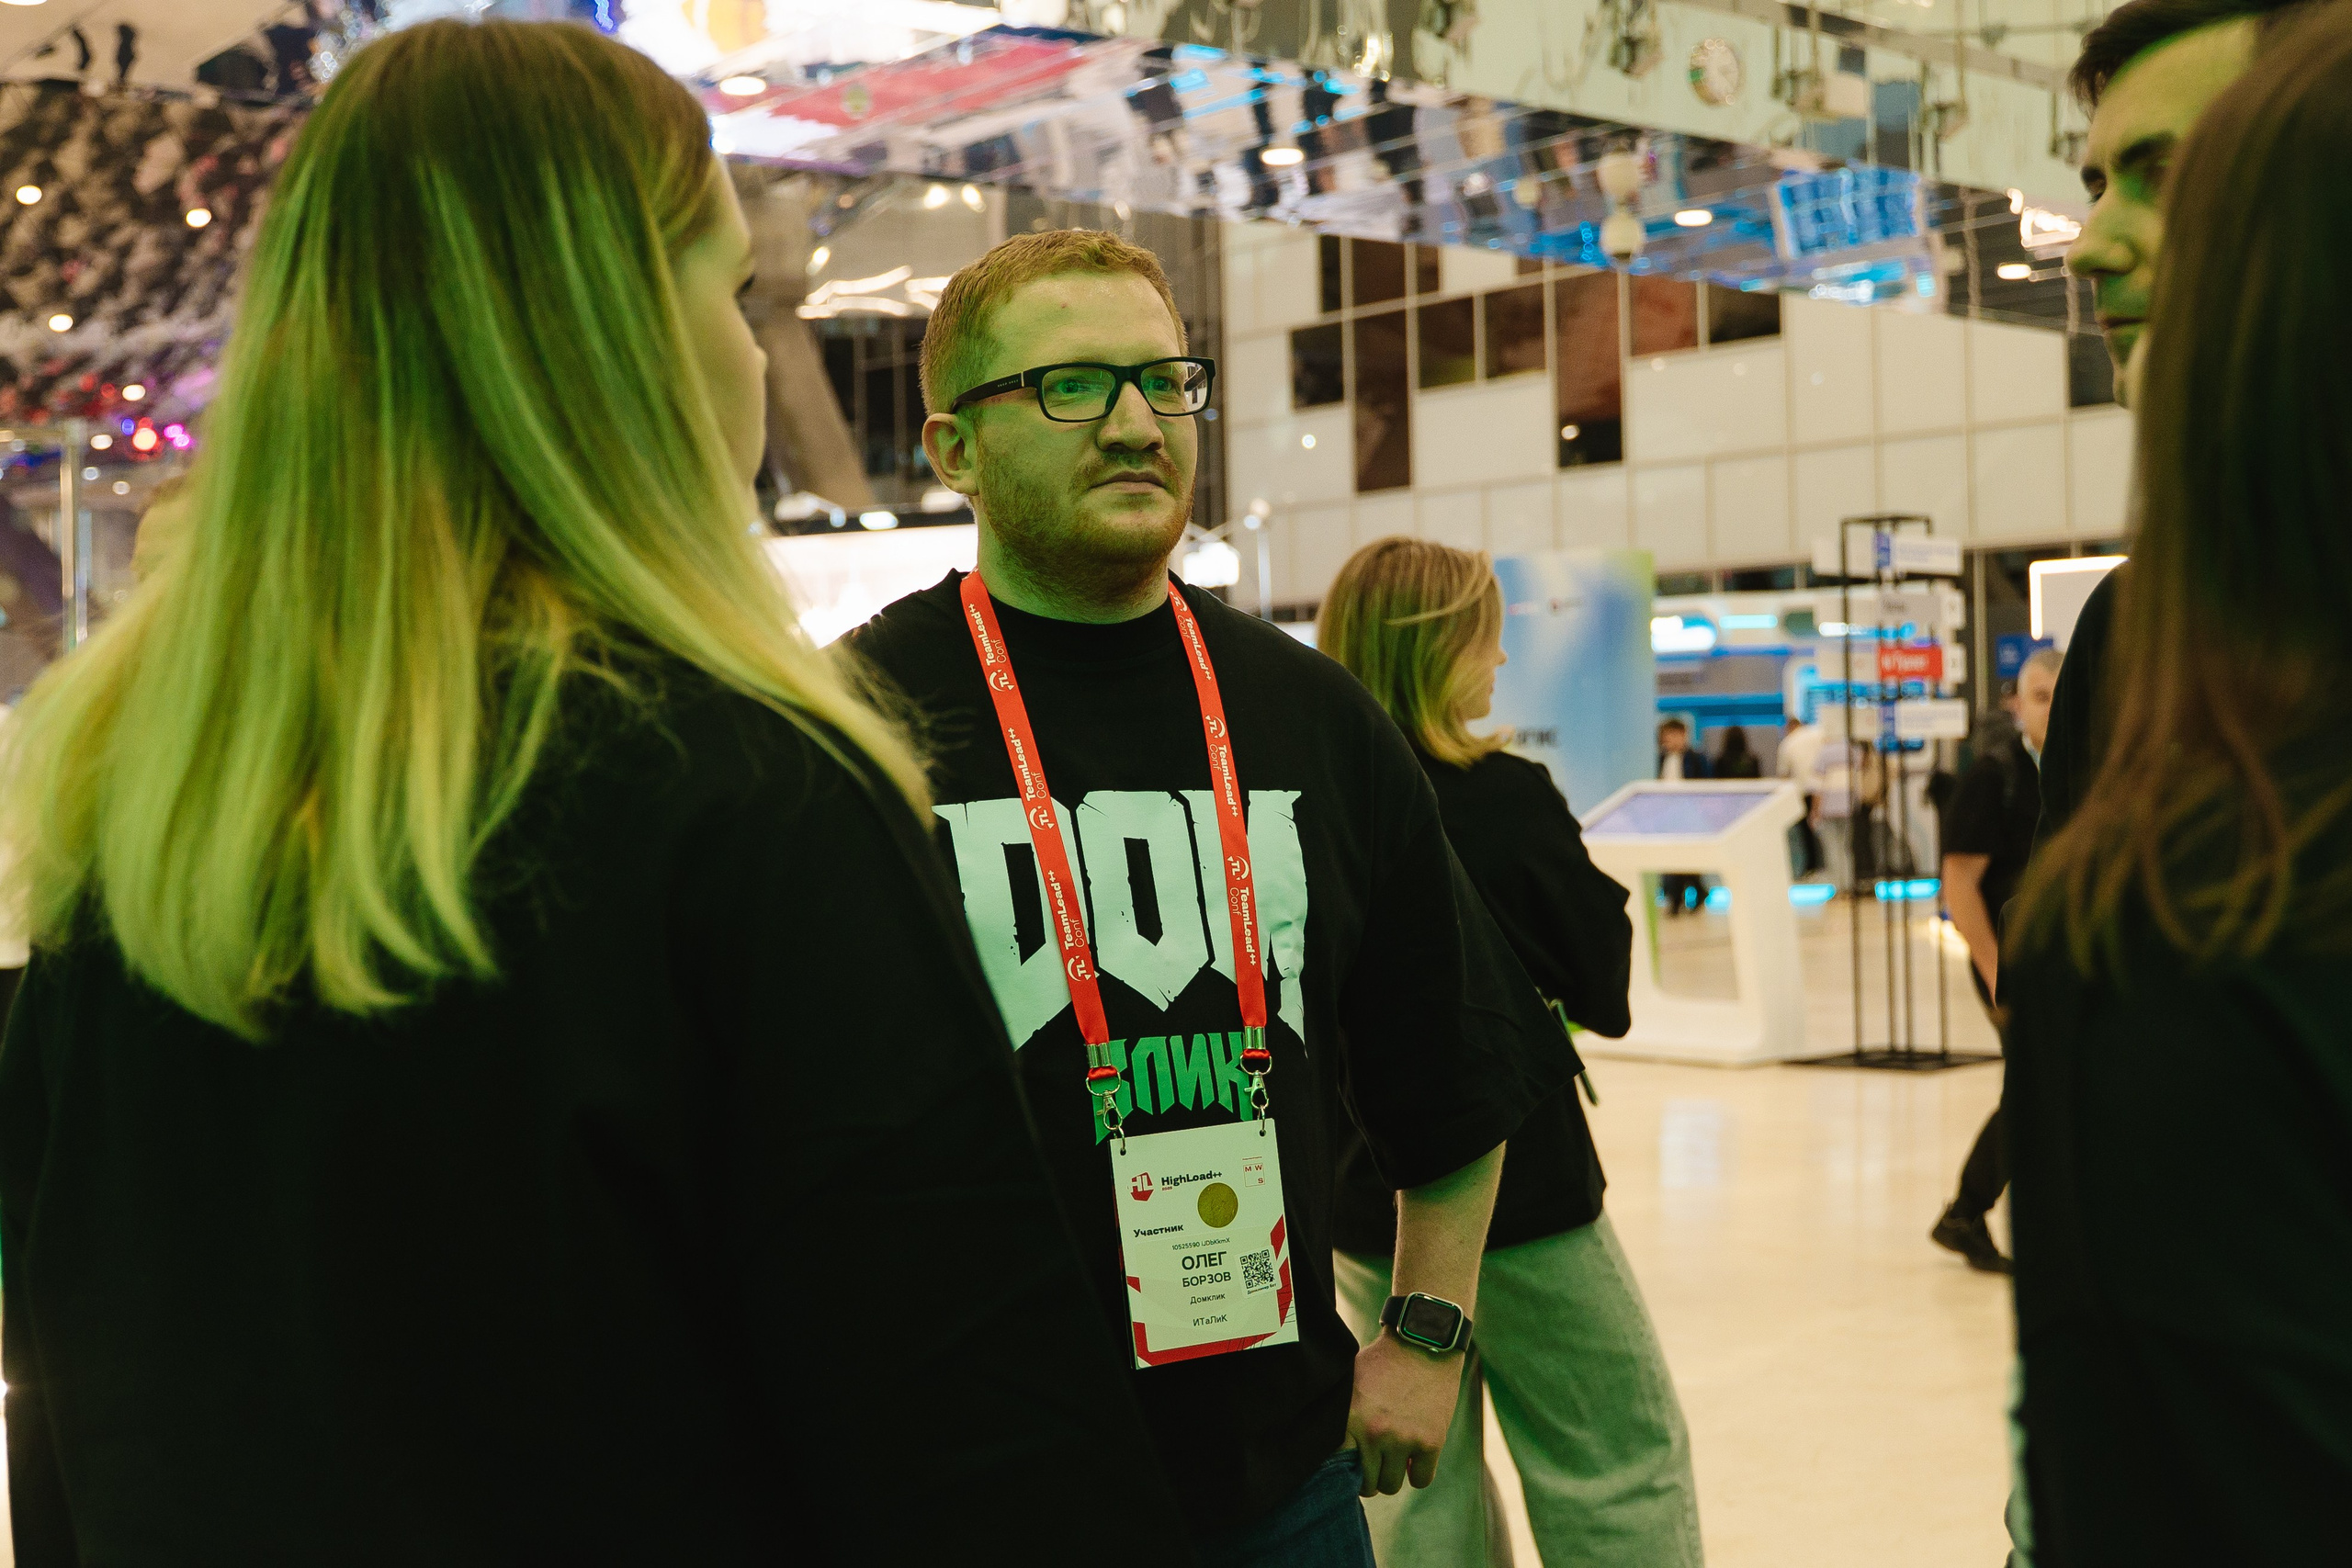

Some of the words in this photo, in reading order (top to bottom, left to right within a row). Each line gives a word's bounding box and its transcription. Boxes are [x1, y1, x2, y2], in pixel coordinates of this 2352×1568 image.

[968, 603, 997, 666] TeamLead++
[1177, 615, 1192, 640] Conf
[990, 638, 1007, 663] Conf
[1184, 616, 1212, 681] TeamLead++
[1008, 728, 1036, 802] TeamLead++
[1209, 743, 1222, 771] Conf
[1031, 772, 1047, 799] Conf
[1218, 744, 1238, 818] TeamLead++
[1047, 870, 1076, 951] TeamLead++
[1229, 887, 1242, 916] Conf
[1069, 919, 1085, 948] Conf
[1240, 886, 1257, 966] TeamLead++
[1161, 1170, 1223, 1187] HighLoad++
[1133, 1224, 1184, 1237] Участник
[1182, 1251, 1227, 1270] ОЛЕГ
[1182, 1271, 1232, 1287] БОРЗОВ
[1190, 1293, 1226, 1304] Домклик
[1193, 1314, 1228, 1326] ИТаЛиК
